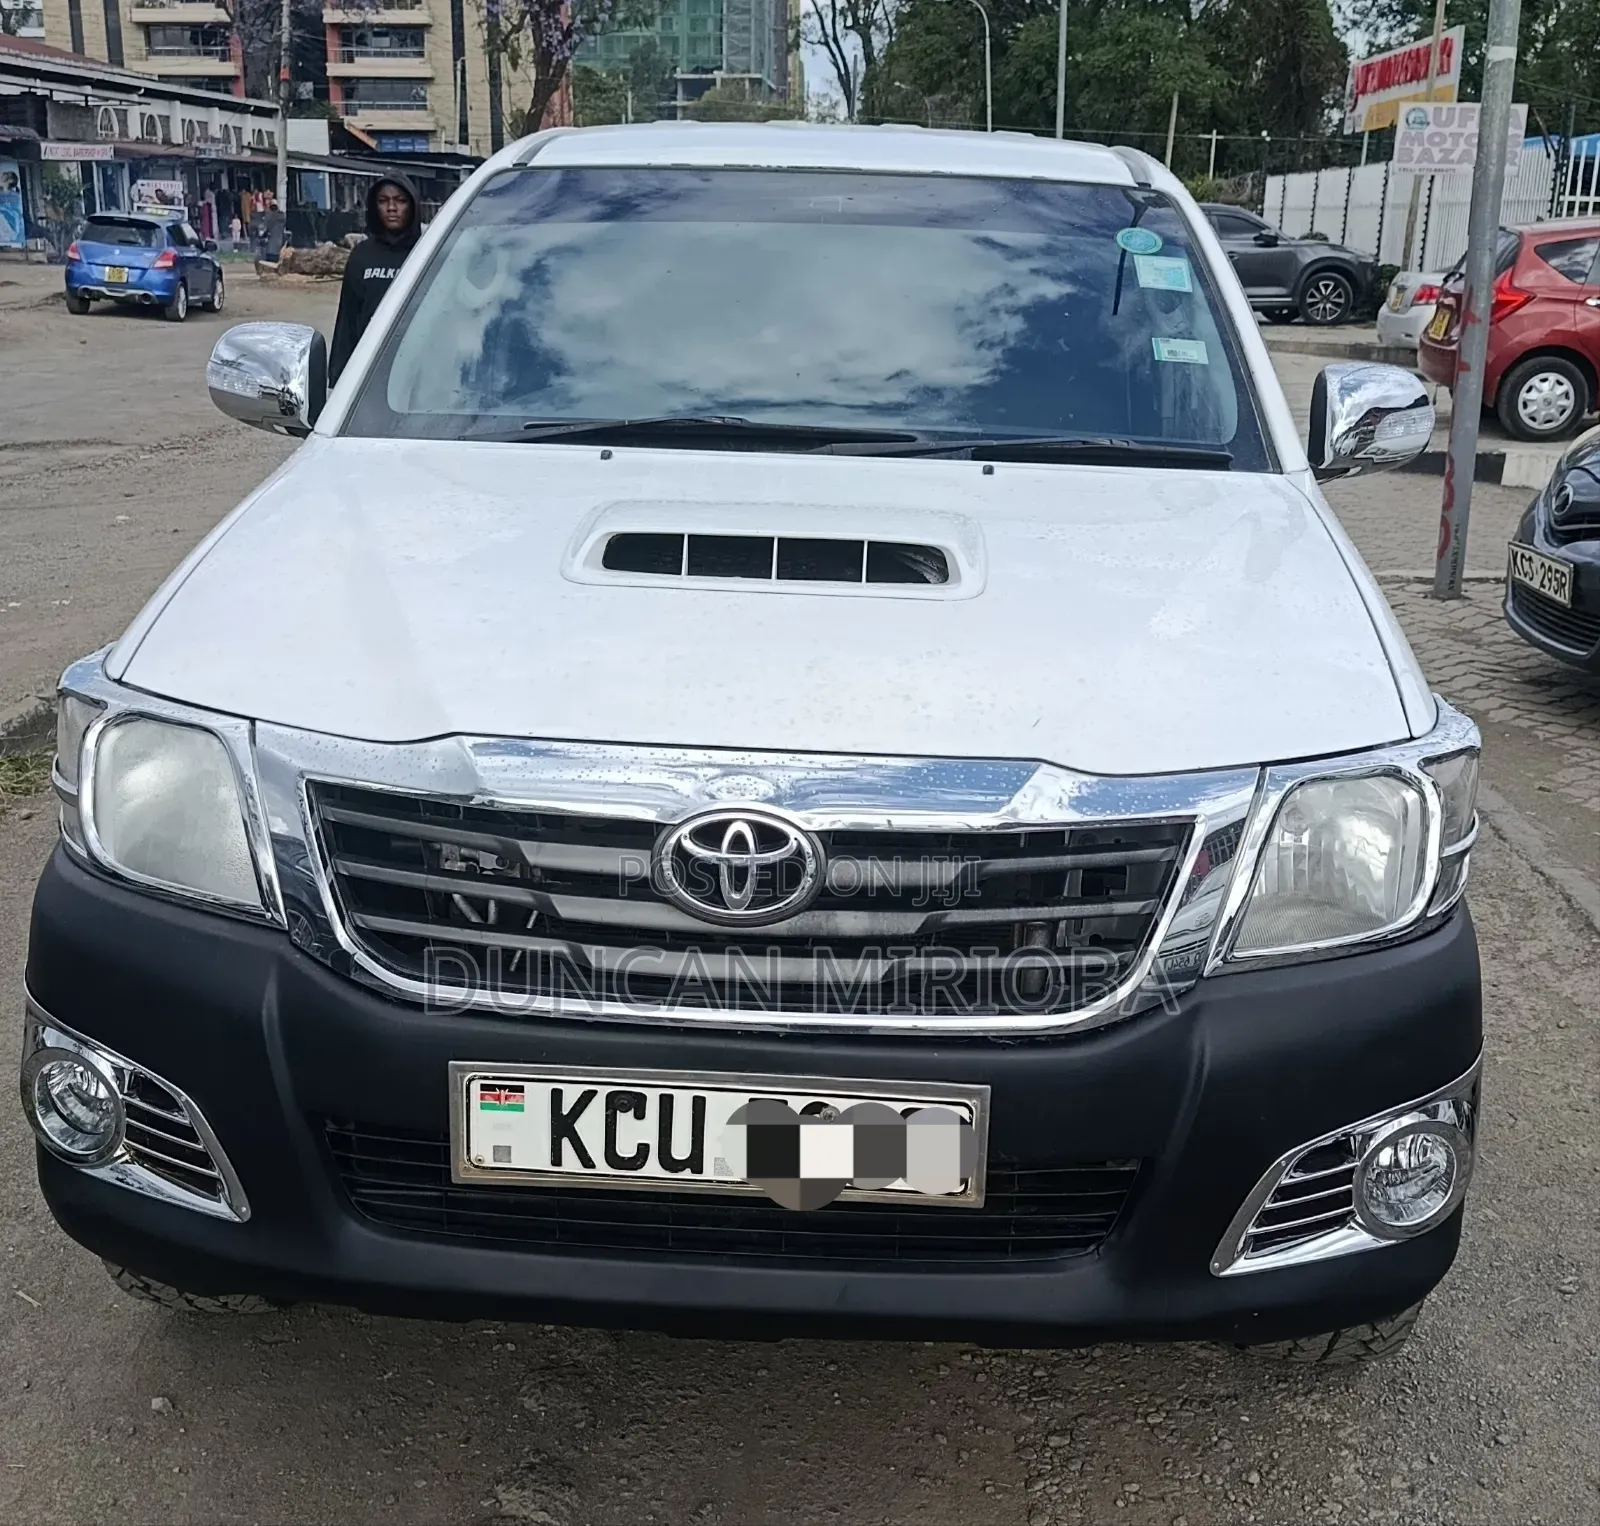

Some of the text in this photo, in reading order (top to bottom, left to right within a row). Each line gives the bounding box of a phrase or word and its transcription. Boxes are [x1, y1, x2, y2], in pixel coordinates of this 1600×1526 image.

[1399, 131, 1523, 148] MOTOS
[1397, 147, 1519, 167] BAZAR
[1539, 561, 1568, 600] 295R
[549, 1086, 706, 1174] KCU
